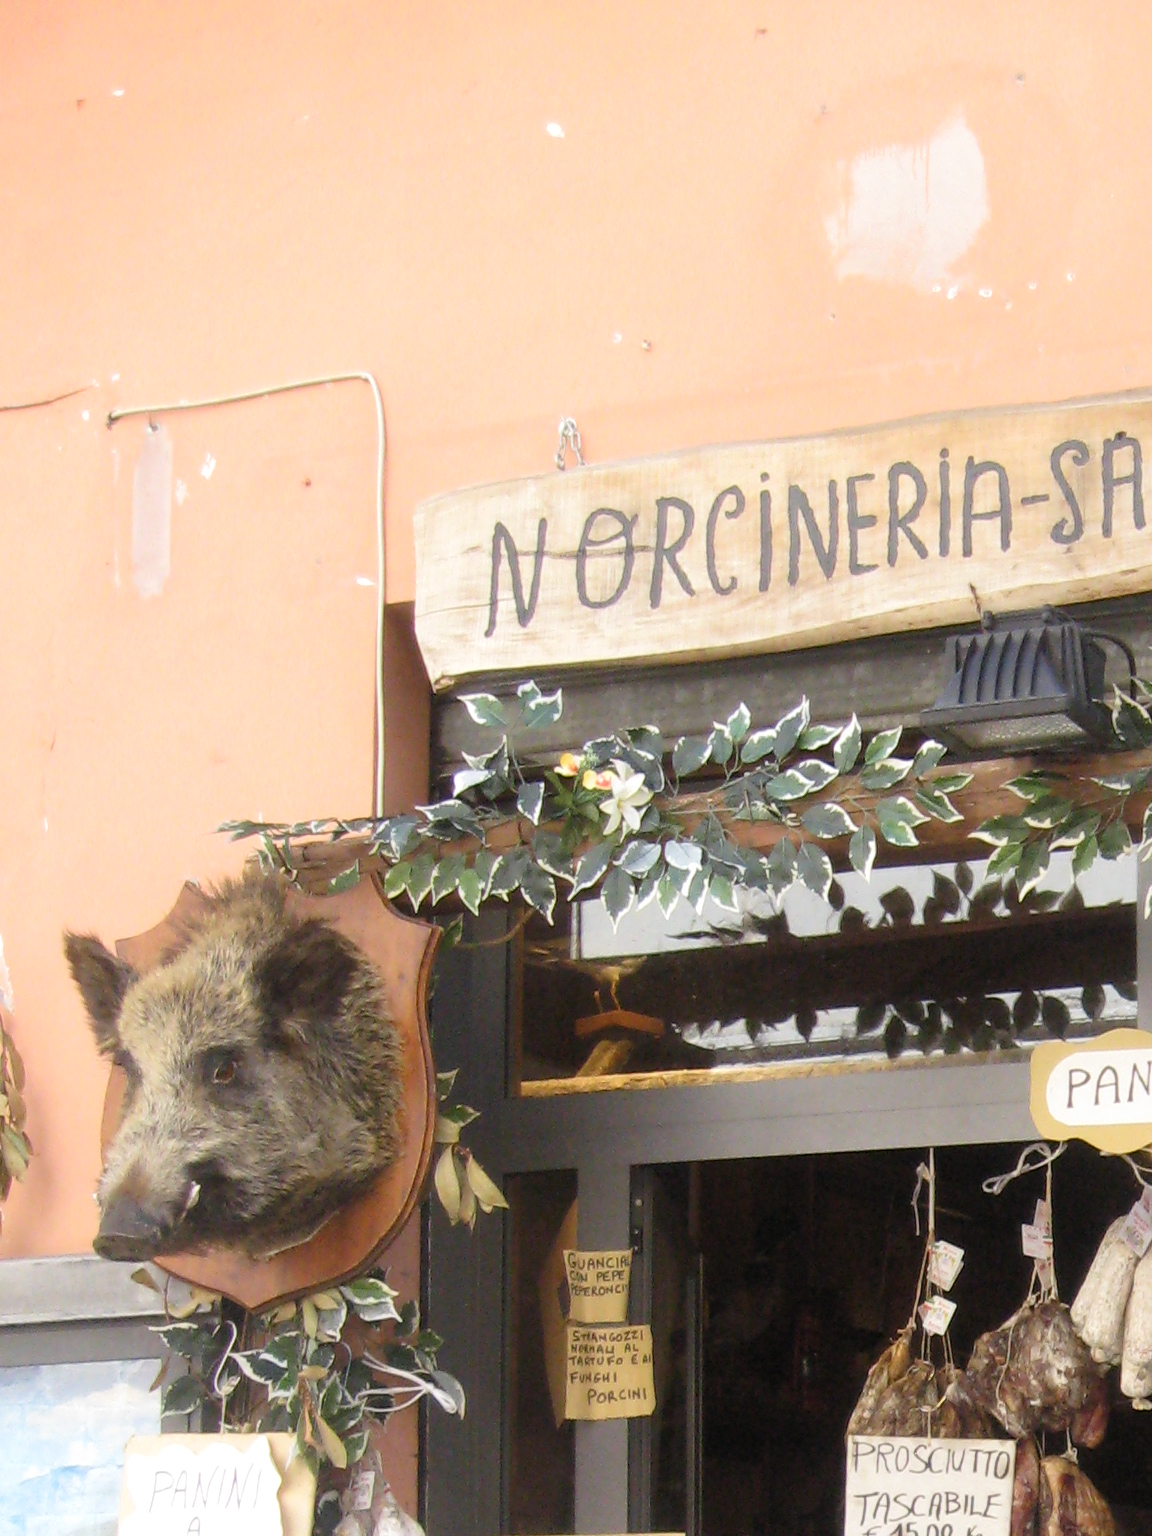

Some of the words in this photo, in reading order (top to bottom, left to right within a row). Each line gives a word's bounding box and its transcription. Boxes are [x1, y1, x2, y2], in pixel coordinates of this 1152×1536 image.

[596, 1270, 625, 1282] PEPE
[572, 1329, 644, 1343] STRANGOZZI
[624, 1342, 639, 1353] AL
[568, 1354, 624, 1366] TARTUFO
[631, 1353, 639, 1365] E
[569, 1371, 617, 1384] FUNGHI
[587, 1387, 647, 1405] PORCINI
[852, 1441, 1011, 1479] PROSCIUTTO
[149, 1462, 262, 1513] PANINI
[853, 1491, 1003, 1526] TASCABILE
